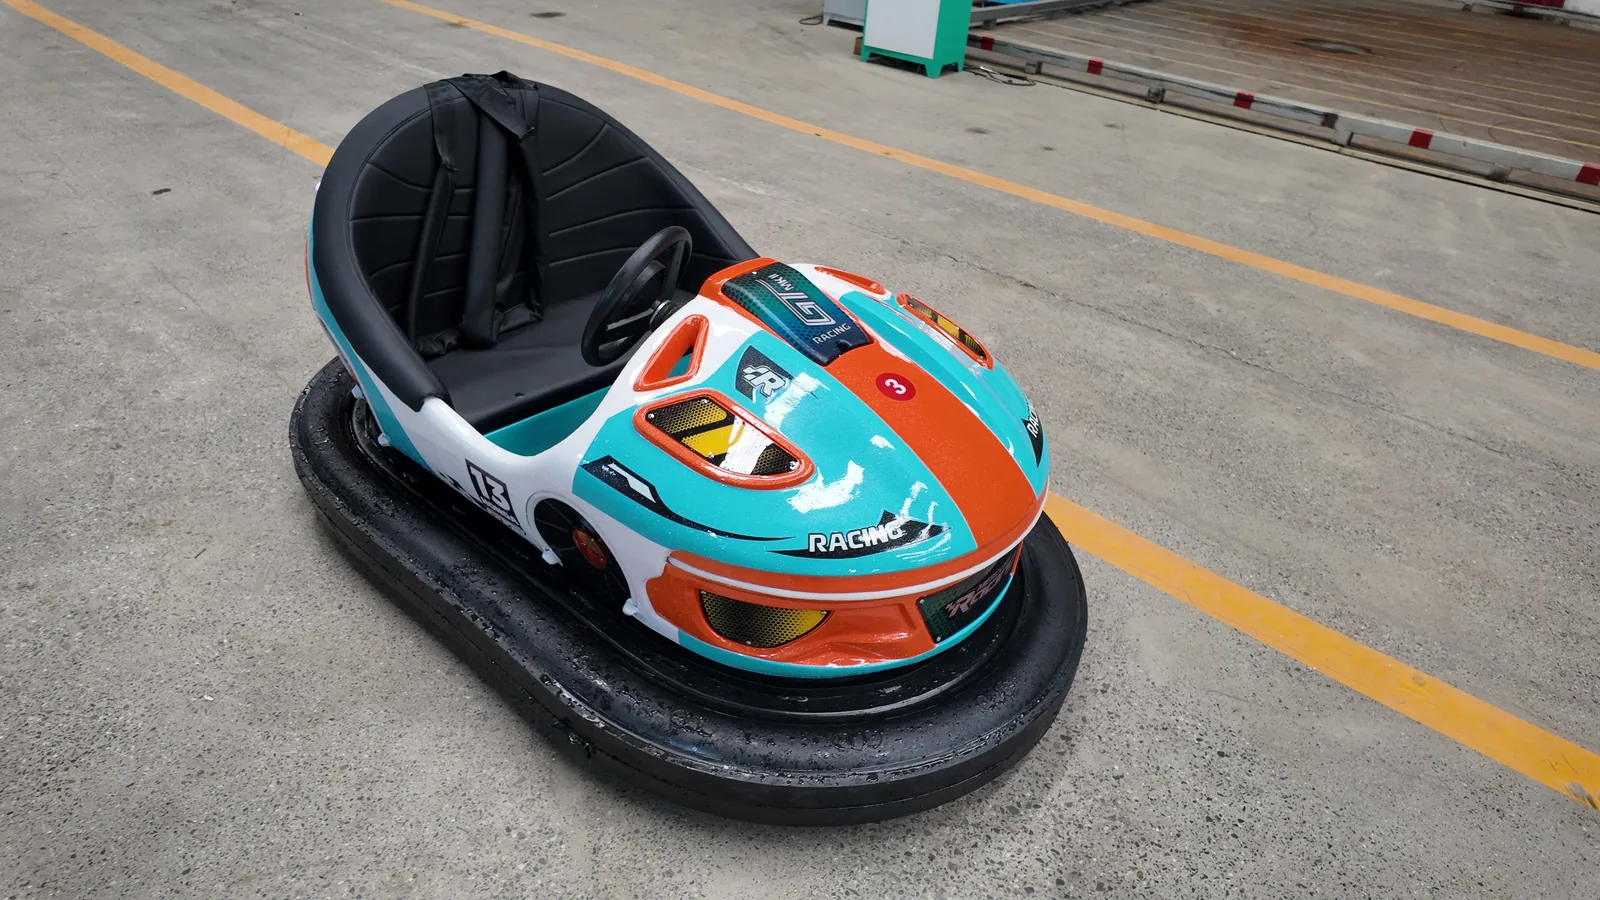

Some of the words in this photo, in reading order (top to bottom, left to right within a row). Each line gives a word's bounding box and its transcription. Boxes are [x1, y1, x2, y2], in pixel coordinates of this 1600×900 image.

[812, 323, 852, 345] RACING
[884, 377, 907, 395] 3
[467, 464, 512, 512] 13
[808, 519, 907, 553] RACING
